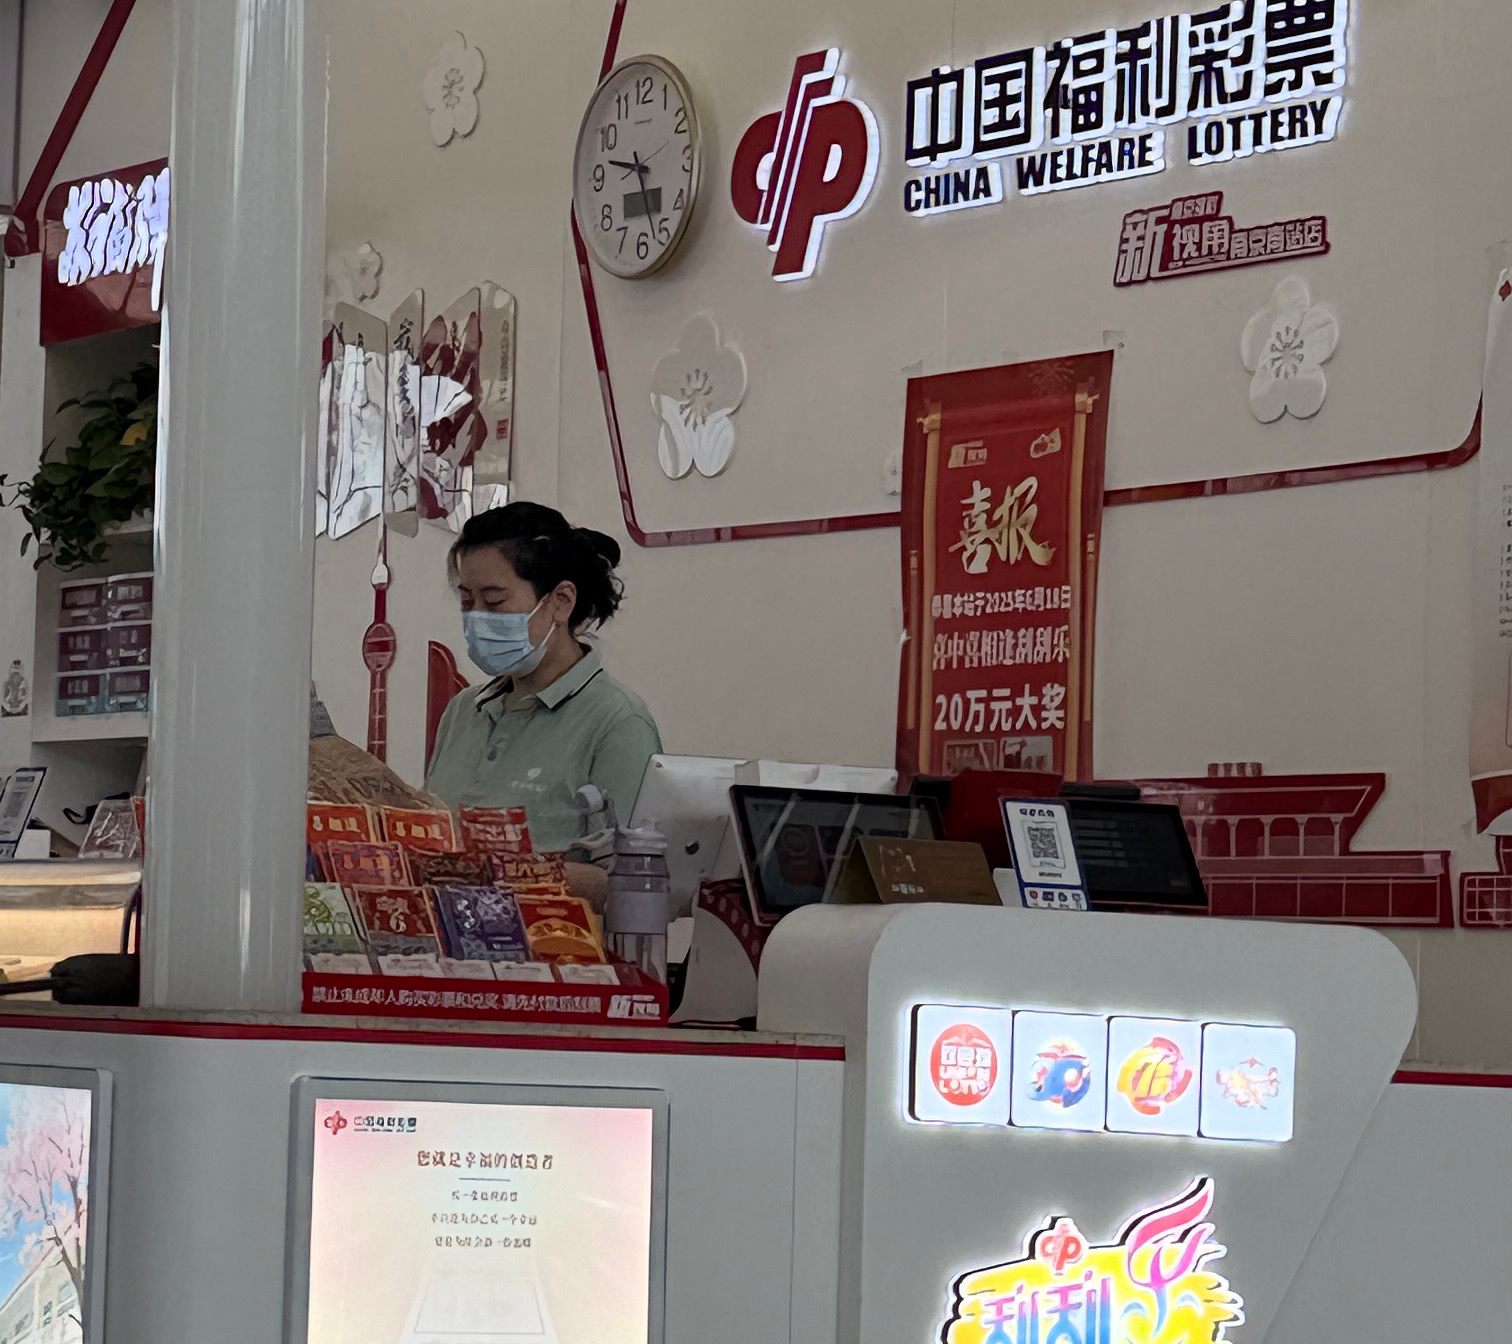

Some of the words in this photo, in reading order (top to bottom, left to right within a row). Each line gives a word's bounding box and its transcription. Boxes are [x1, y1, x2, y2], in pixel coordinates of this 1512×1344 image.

[636, 76, 654, 106] 12
[616, 92, 630, 120] 11
[674, 106, 688, 135] 2
[599, 123, 618, 153] 10
[903, 163, 1001, 216] CHINA
[1017, 131, 1165, 195] WELFARE
[1188, 96, 1343, 165] LOTTERY
[593, 164, 605, 193] 9
[600, 204, 614, 232] 8
[657, 217, 671, 247] 5
[616, 226, 629, 255] 7
[636, 232, 649, 260] 6
[948, 476, 1057, 575] 喜报
[934, 682, 1067, 733] 20万元大奖
